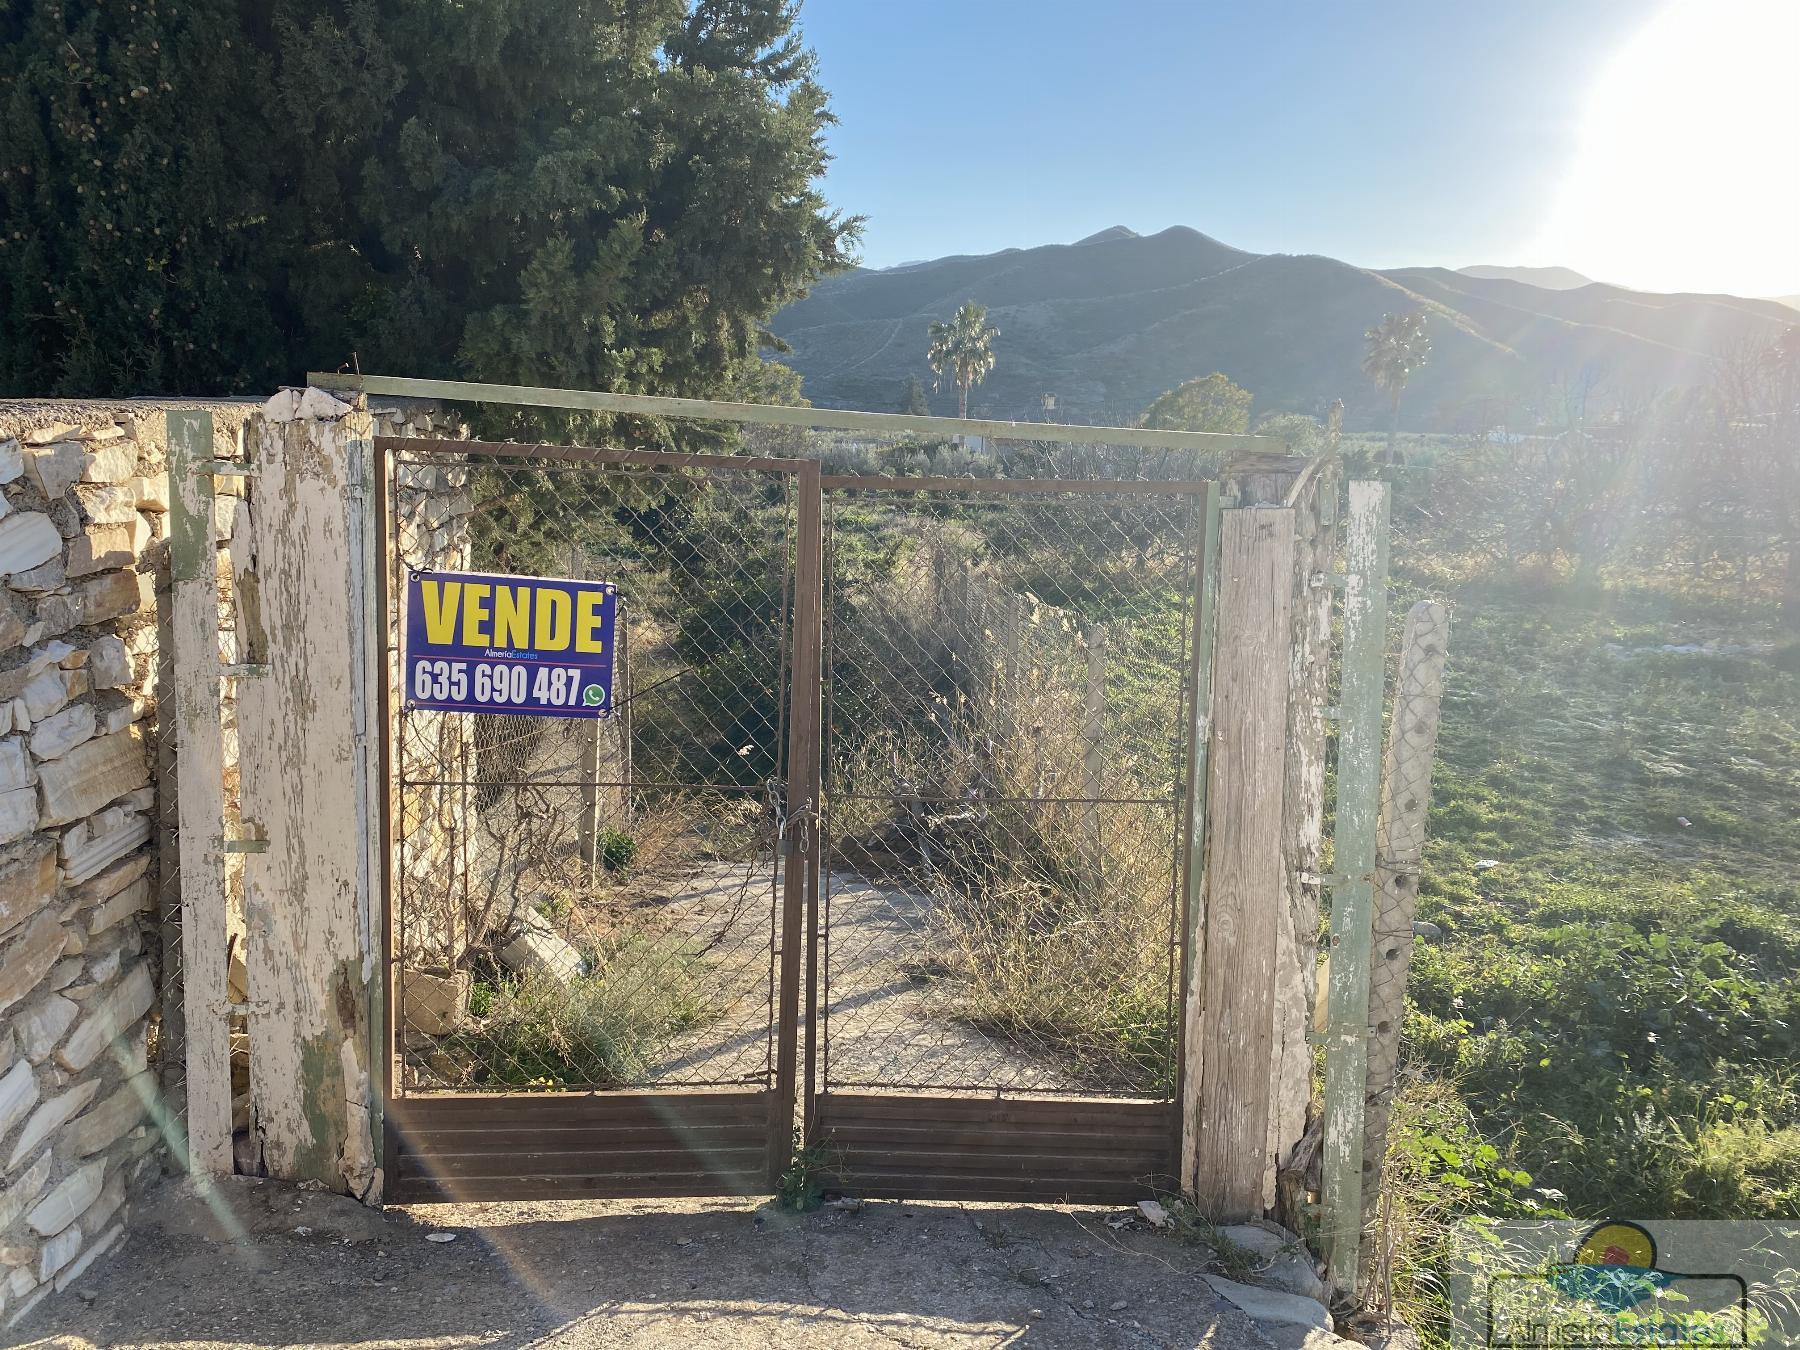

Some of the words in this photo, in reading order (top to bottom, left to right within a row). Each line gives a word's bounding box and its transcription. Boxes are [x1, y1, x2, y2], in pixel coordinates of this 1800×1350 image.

[421, 580, 603, 653] VENDE
[415, 660, 468, 701] 635
[474, 661, 528, 704] 690
[532, 667, 581, 706] 487
